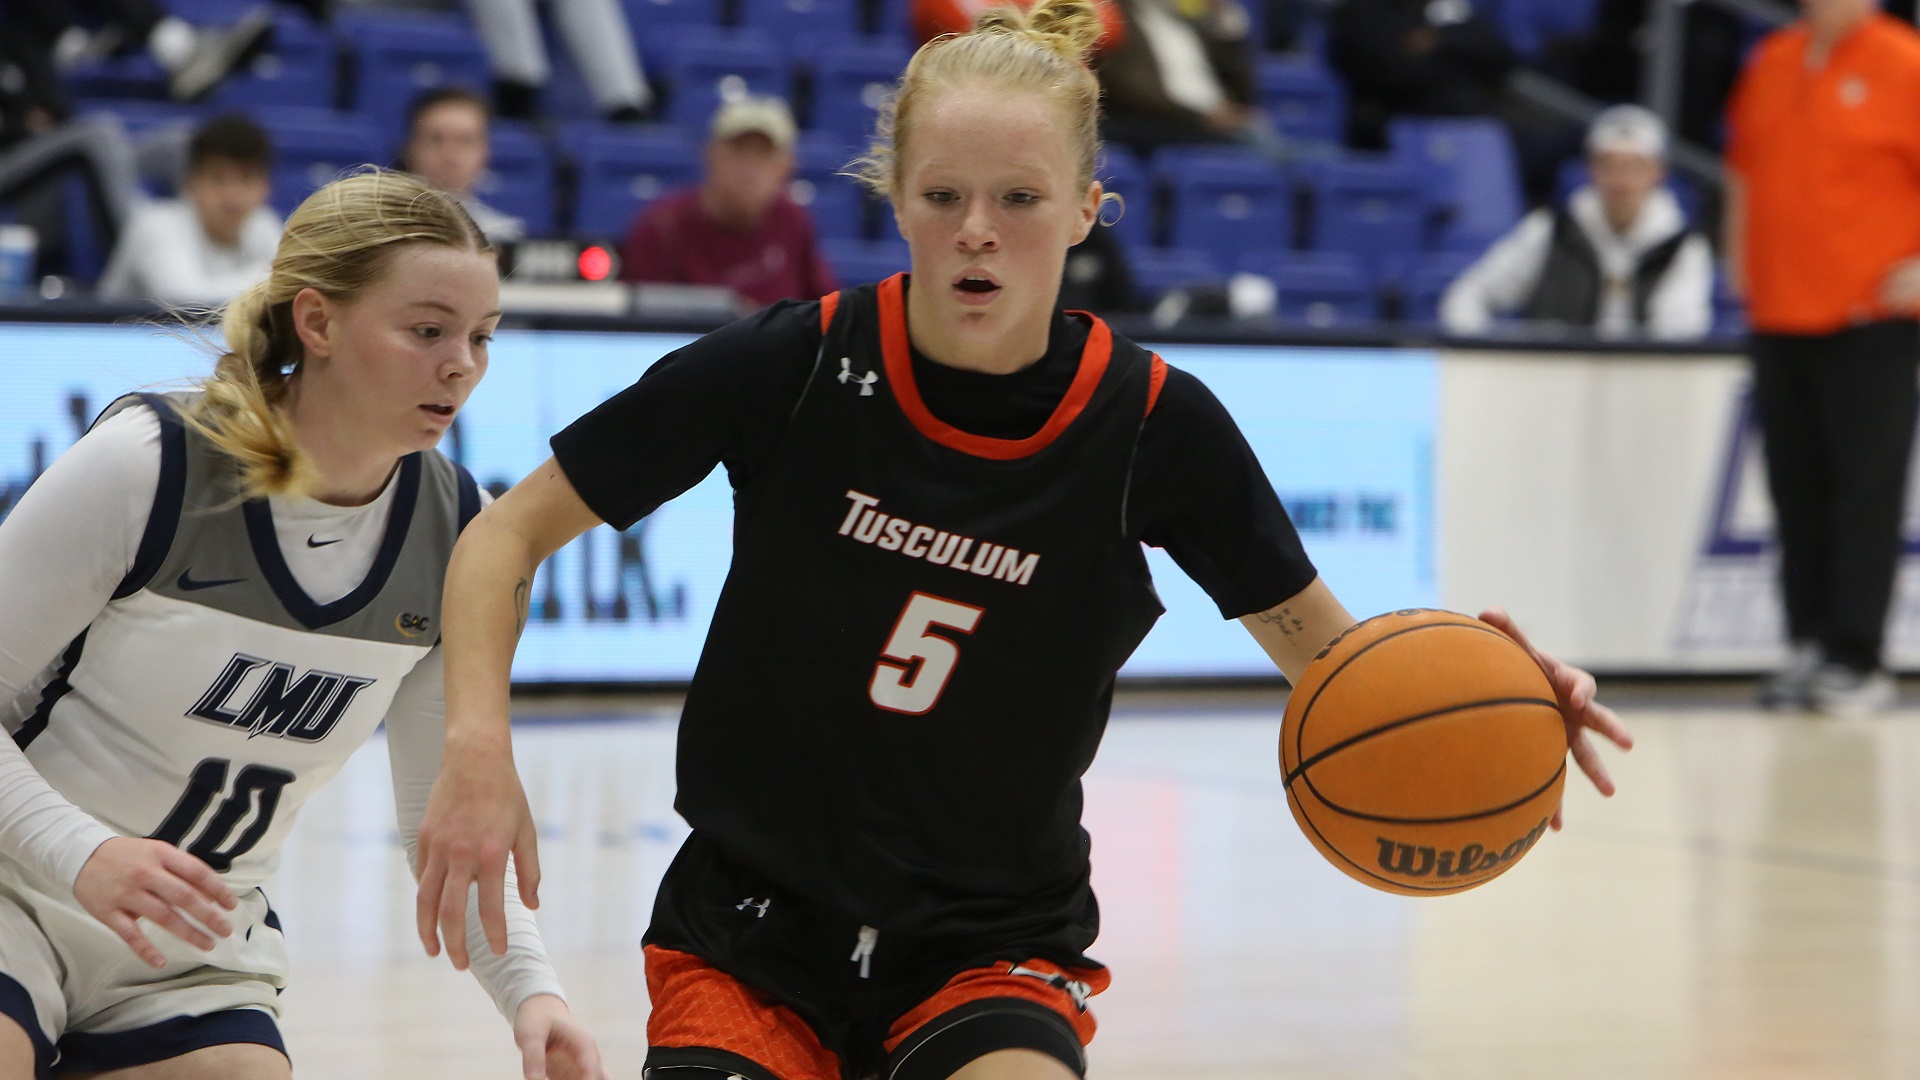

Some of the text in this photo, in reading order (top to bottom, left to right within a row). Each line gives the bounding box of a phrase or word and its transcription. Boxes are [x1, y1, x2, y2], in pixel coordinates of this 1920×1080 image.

[400, 612, 429, 632] SAC
[867, 590, 987, 716] 5
[184, 652, 378, 744] LMU
[142, 756, 297, 874] 10
